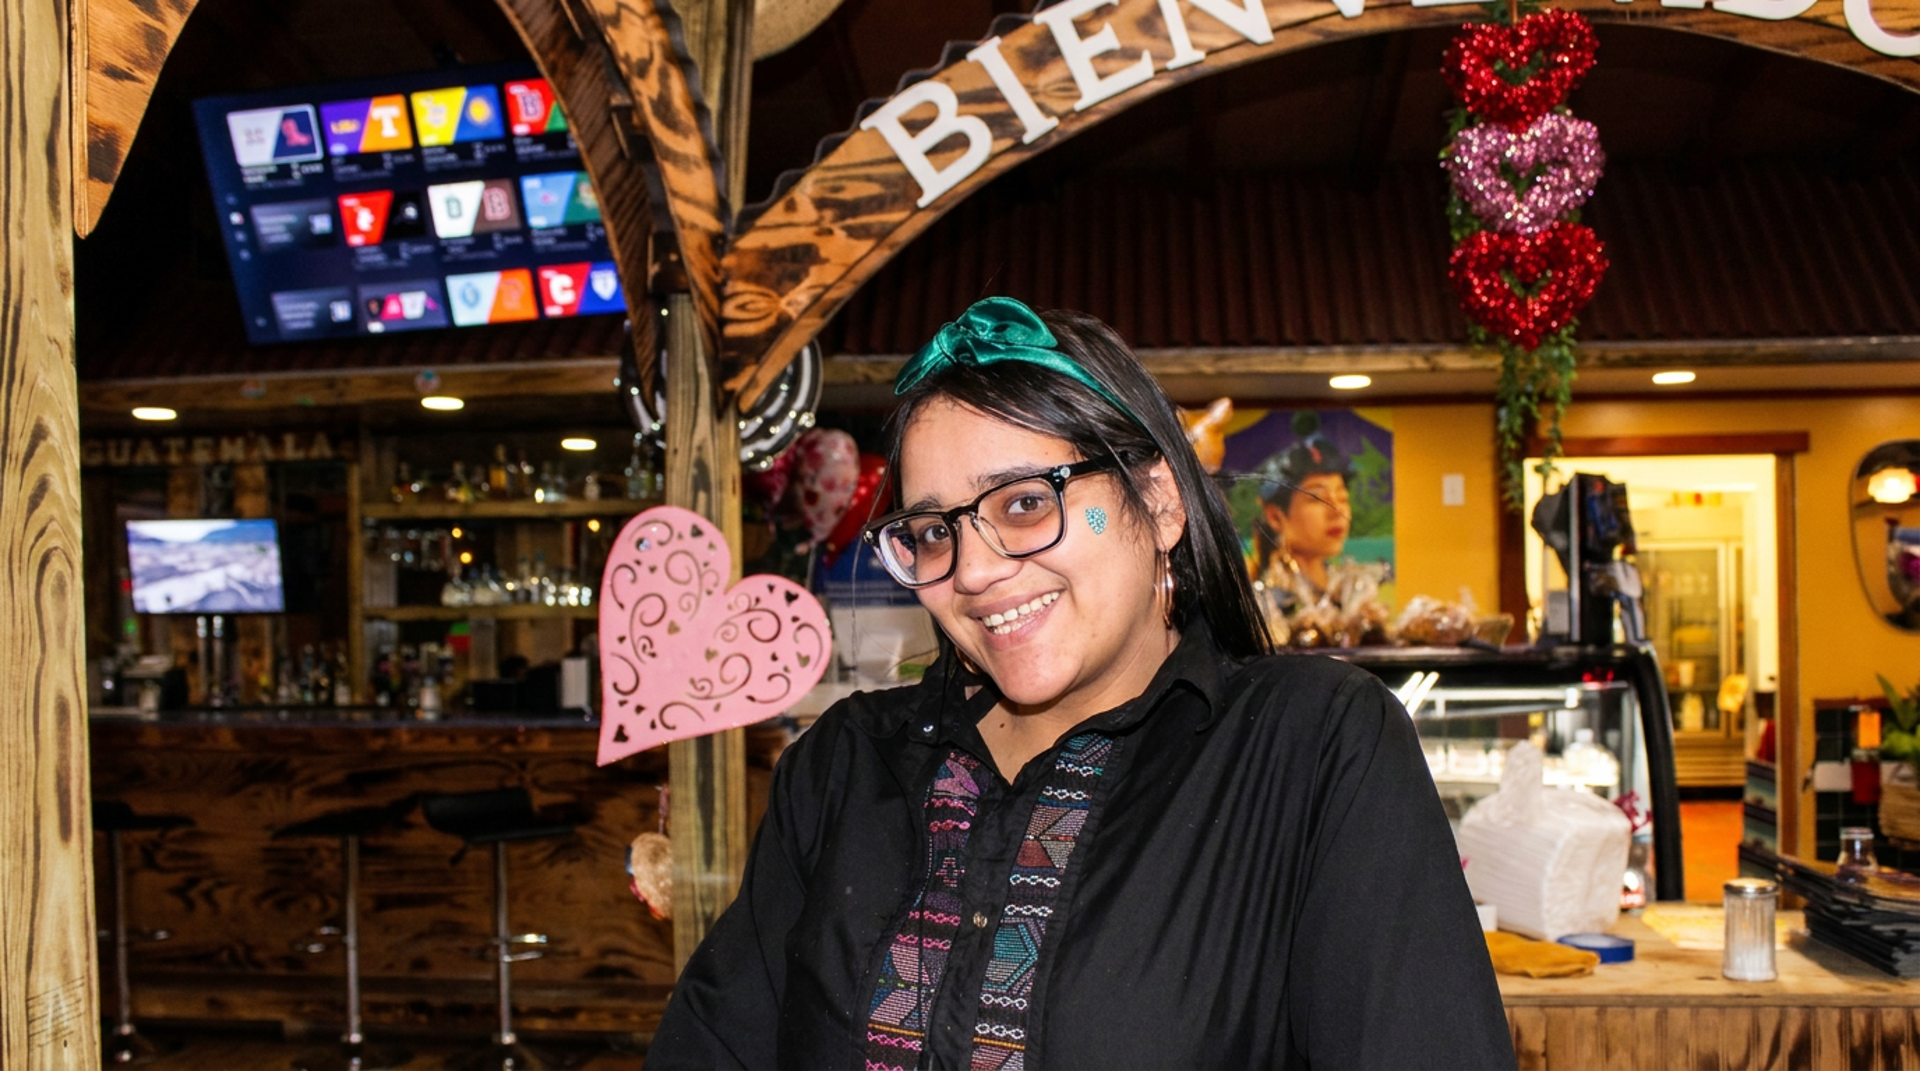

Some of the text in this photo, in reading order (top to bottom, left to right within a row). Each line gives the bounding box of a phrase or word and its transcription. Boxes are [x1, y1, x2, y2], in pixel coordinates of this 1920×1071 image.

[371, 105, 400, 138] T
[549, 274, 576, 305] C
[82, 432, 334, 466] GUATEMALA
